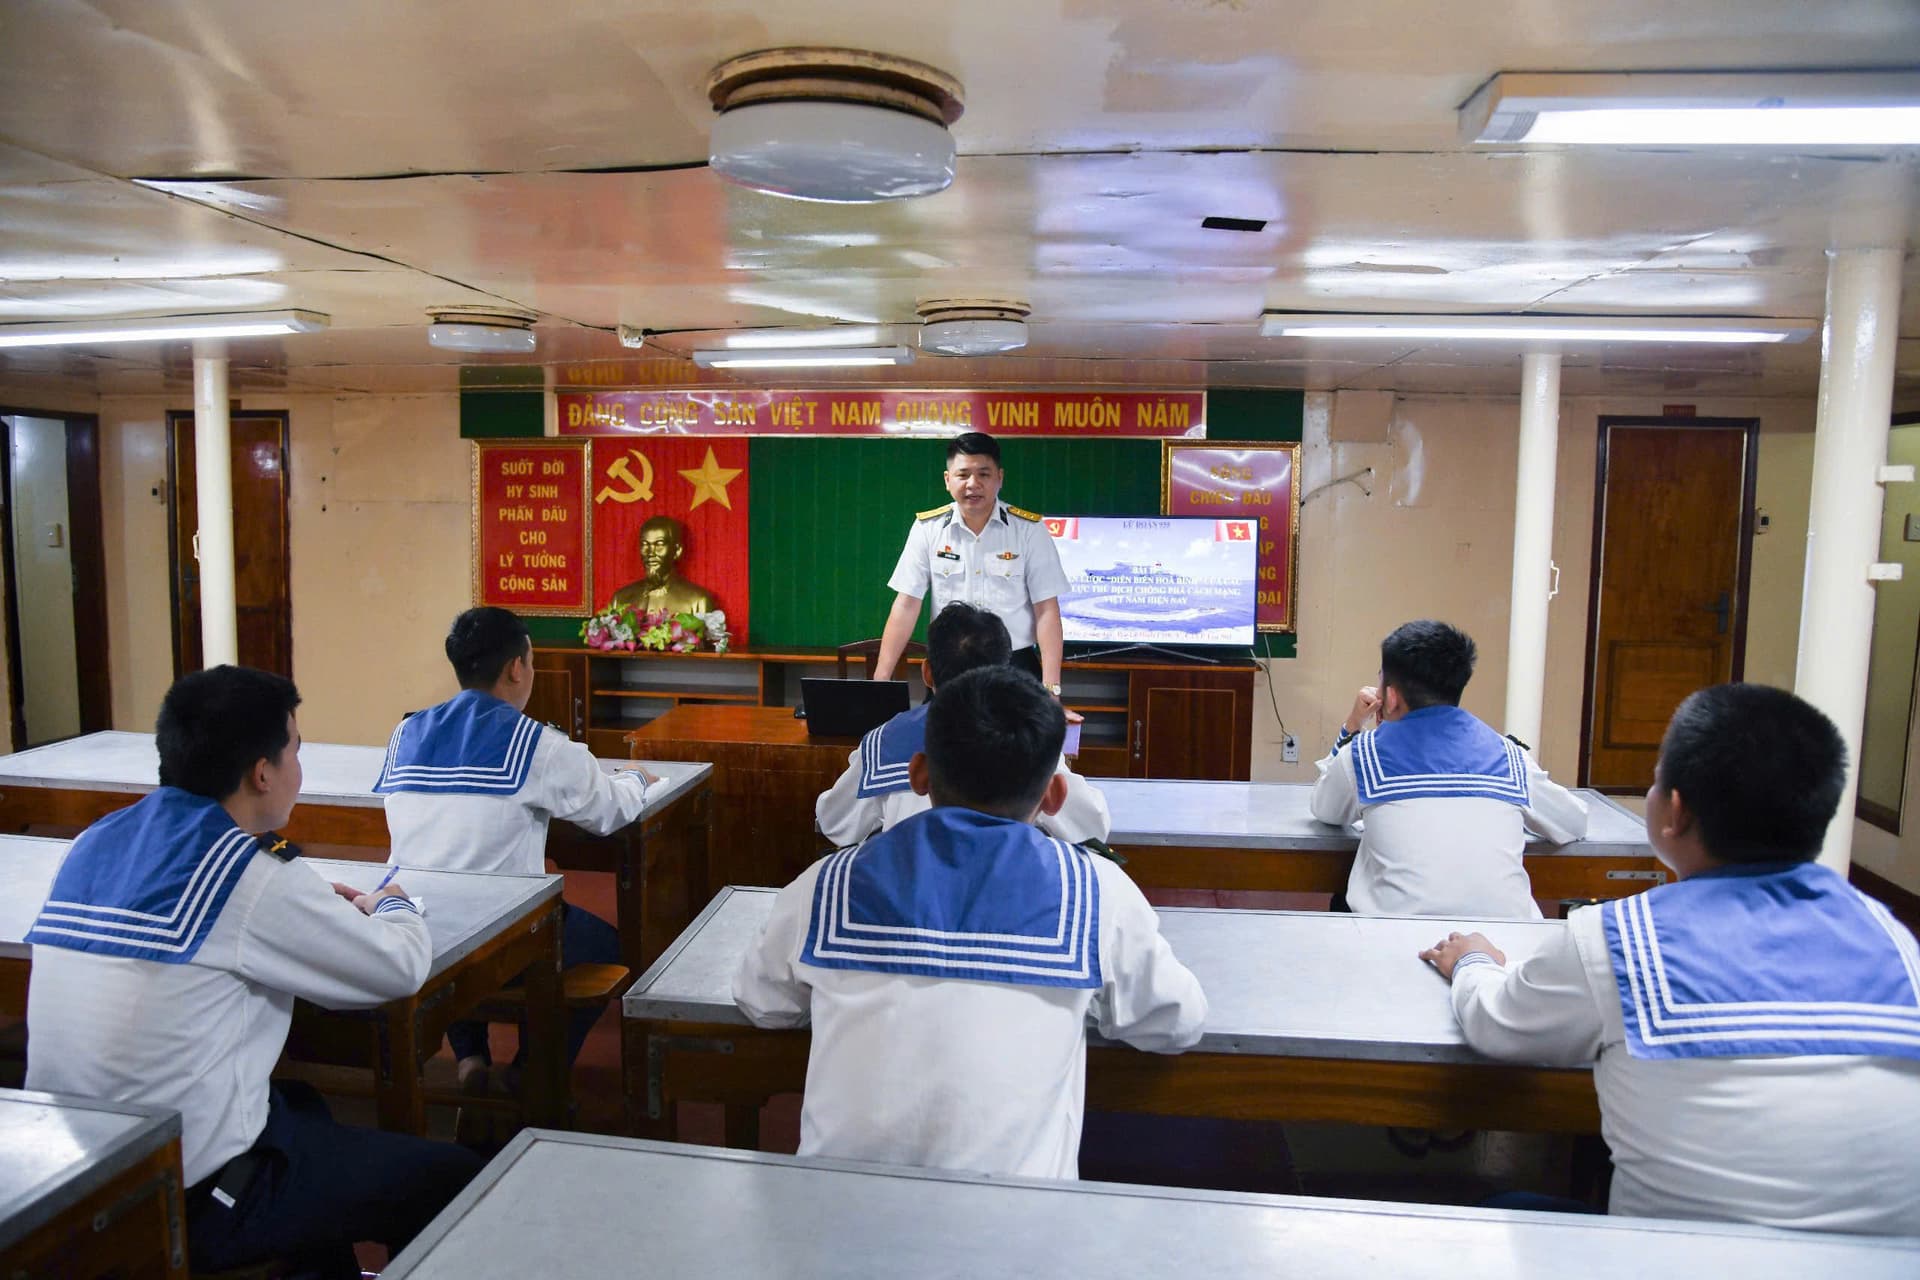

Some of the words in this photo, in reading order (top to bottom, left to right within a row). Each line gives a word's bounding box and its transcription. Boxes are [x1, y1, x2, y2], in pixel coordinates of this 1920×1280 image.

[568, 394, 625, 427] ĐẢNG
[770, 396, 818, 430] VIỆT
[831, 401, 881, 426] NAM
[896, 400, 972, 428] QUANG
[987, 402, 1039, 427] VINH
[1054, 396, 1121, 427] MUÔN
[1137, 398, 1190, 427] NĂM
[502, 458, 534, 476] SUỐT
[542, 458, 565, 476] ĐỜI
[507, 485, 524, 498] HY
[529, 485, 558, 499] SINH
[499, 504, 533, 522] PHẤN
[542, 504, 567, 522] ĐẤU
[519, 531, 547, 545] CHO
[500, 551, 514, 568] LÝ
[523, 549, 566, 568] TƯỞNG
[500, 574, 535, 594] CỘNG
[541, 573, 567, 592] SẢN
